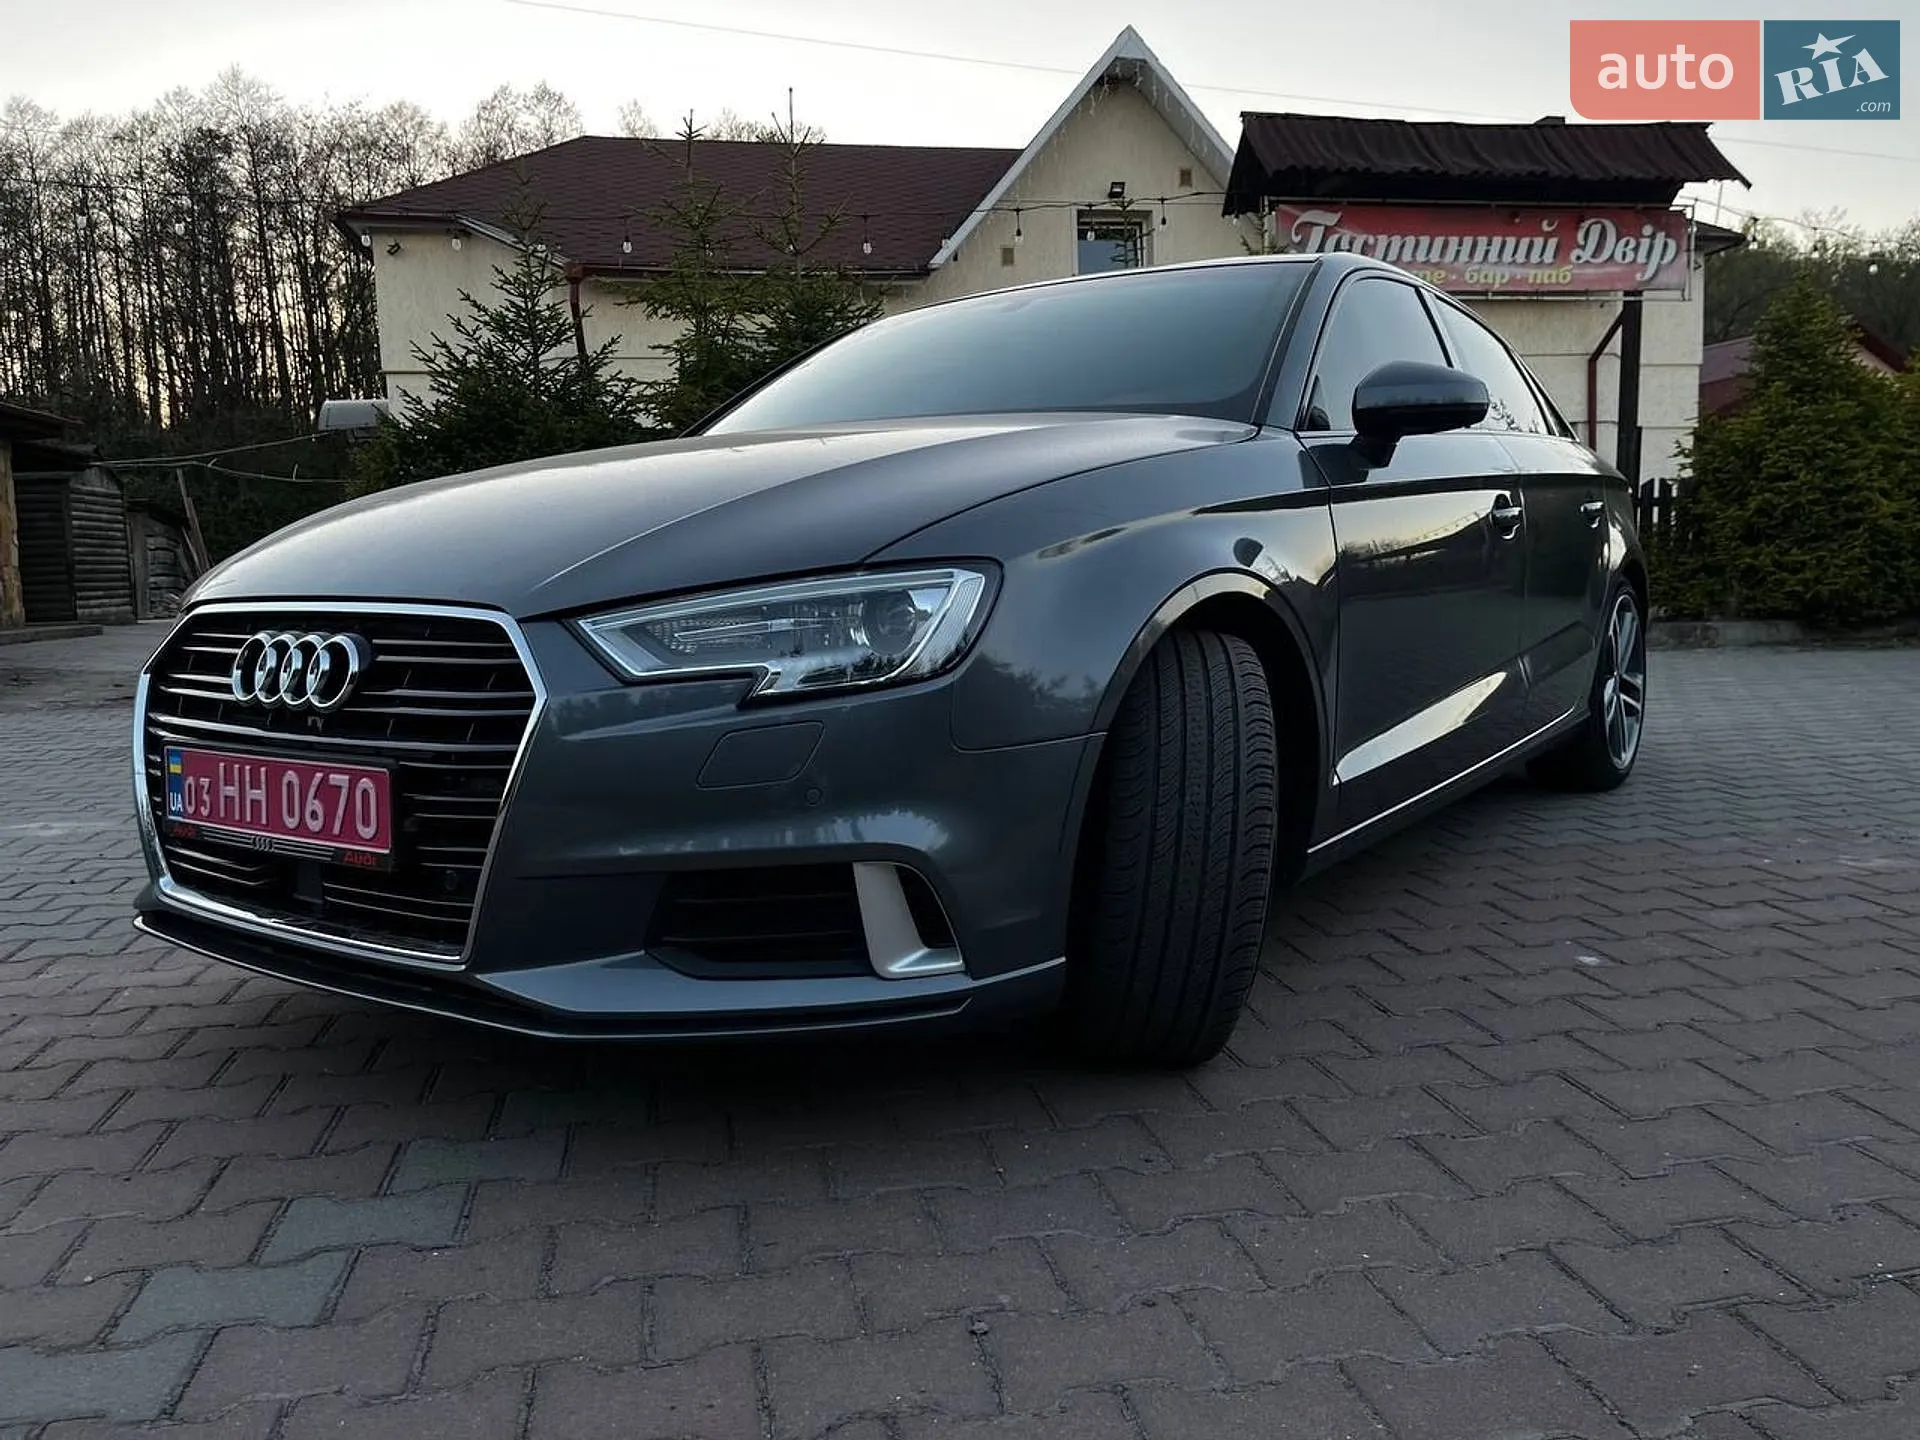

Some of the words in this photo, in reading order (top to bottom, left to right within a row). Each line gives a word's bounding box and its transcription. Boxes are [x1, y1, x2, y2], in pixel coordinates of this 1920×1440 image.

[1570, 217, 1678, 281] Двір
[1464, 265, 1510, 289] бар
[1527, 264, 1574, 285] паб
[169, 794, 184, 812] UA
[184, 776, 212, 817] 03
[281, 769, 379, 841] 0670
